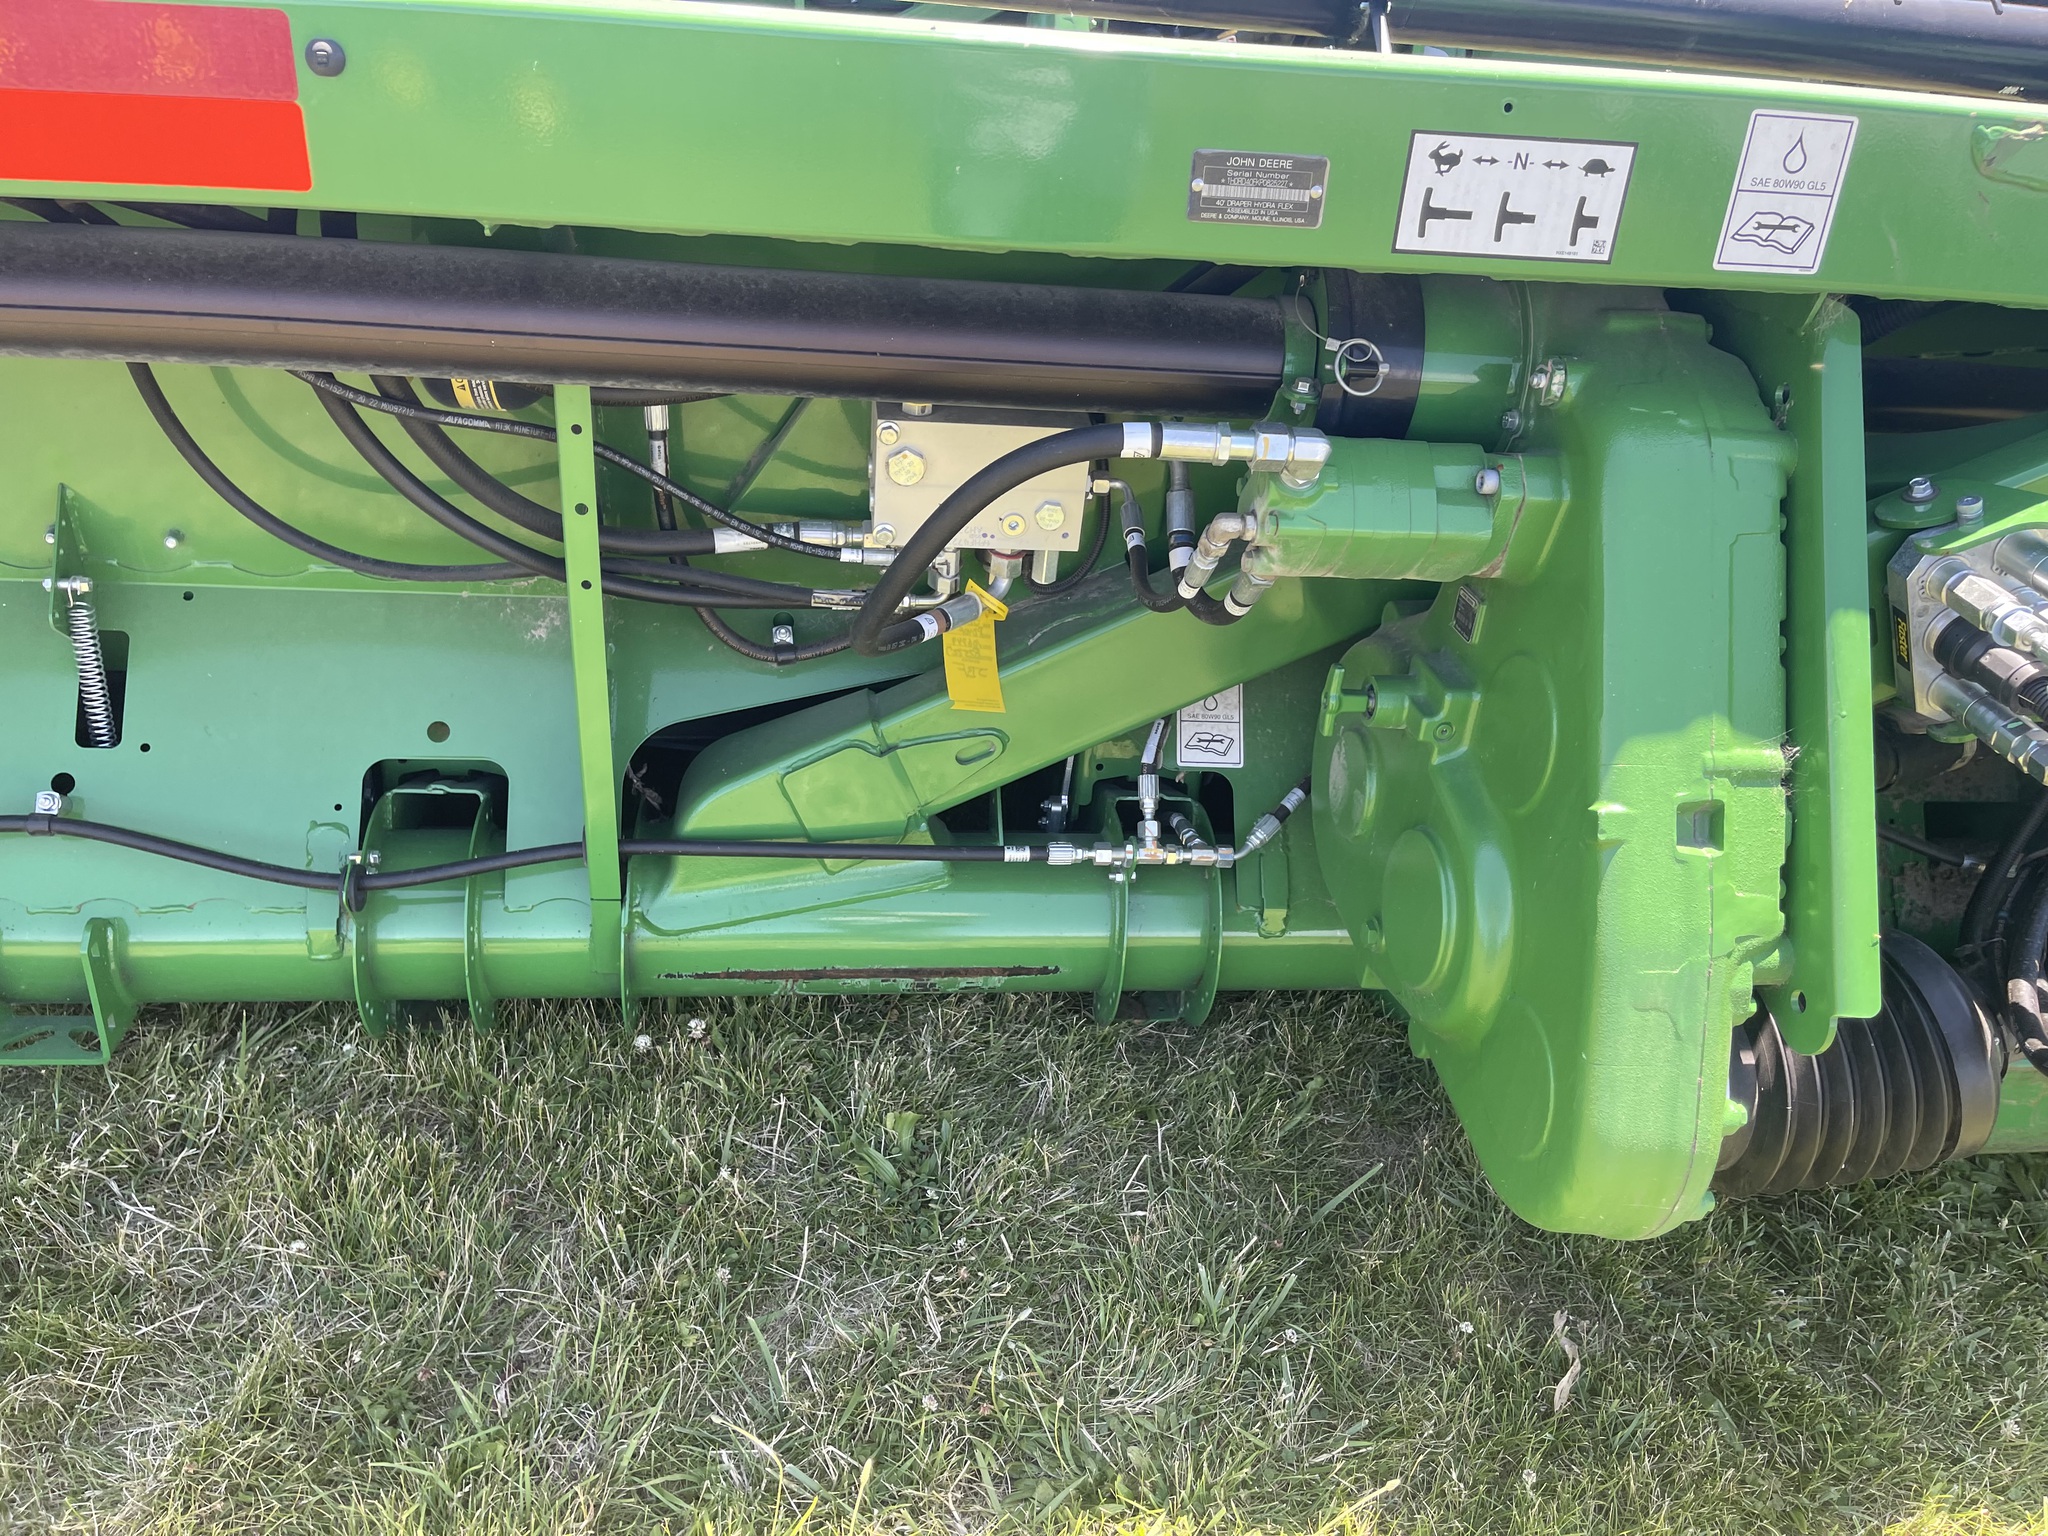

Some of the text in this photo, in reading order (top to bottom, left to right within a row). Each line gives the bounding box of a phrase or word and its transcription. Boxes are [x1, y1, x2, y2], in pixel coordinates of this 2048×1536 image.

[1227, 157, 1293, 169] JOHN DEERE
[1227, 170, 1289, 179] Serial Number
[1750, 177, 1828, 191] SAE 80W90 GL5
[1226, 199, 1253, 208] DRAPER
[1253, 201, 1276, 210] HYDRA
[1277, 202, 1294, 211] FLEX
[1226, 207, 1259, 215] ASSEMBLED
[666, 484, 689, 501] exceeds
[702, 502, 713, 515] 100
[730, 518, 739, 527] EN
[1897, 617, 1909, 663] Faster
